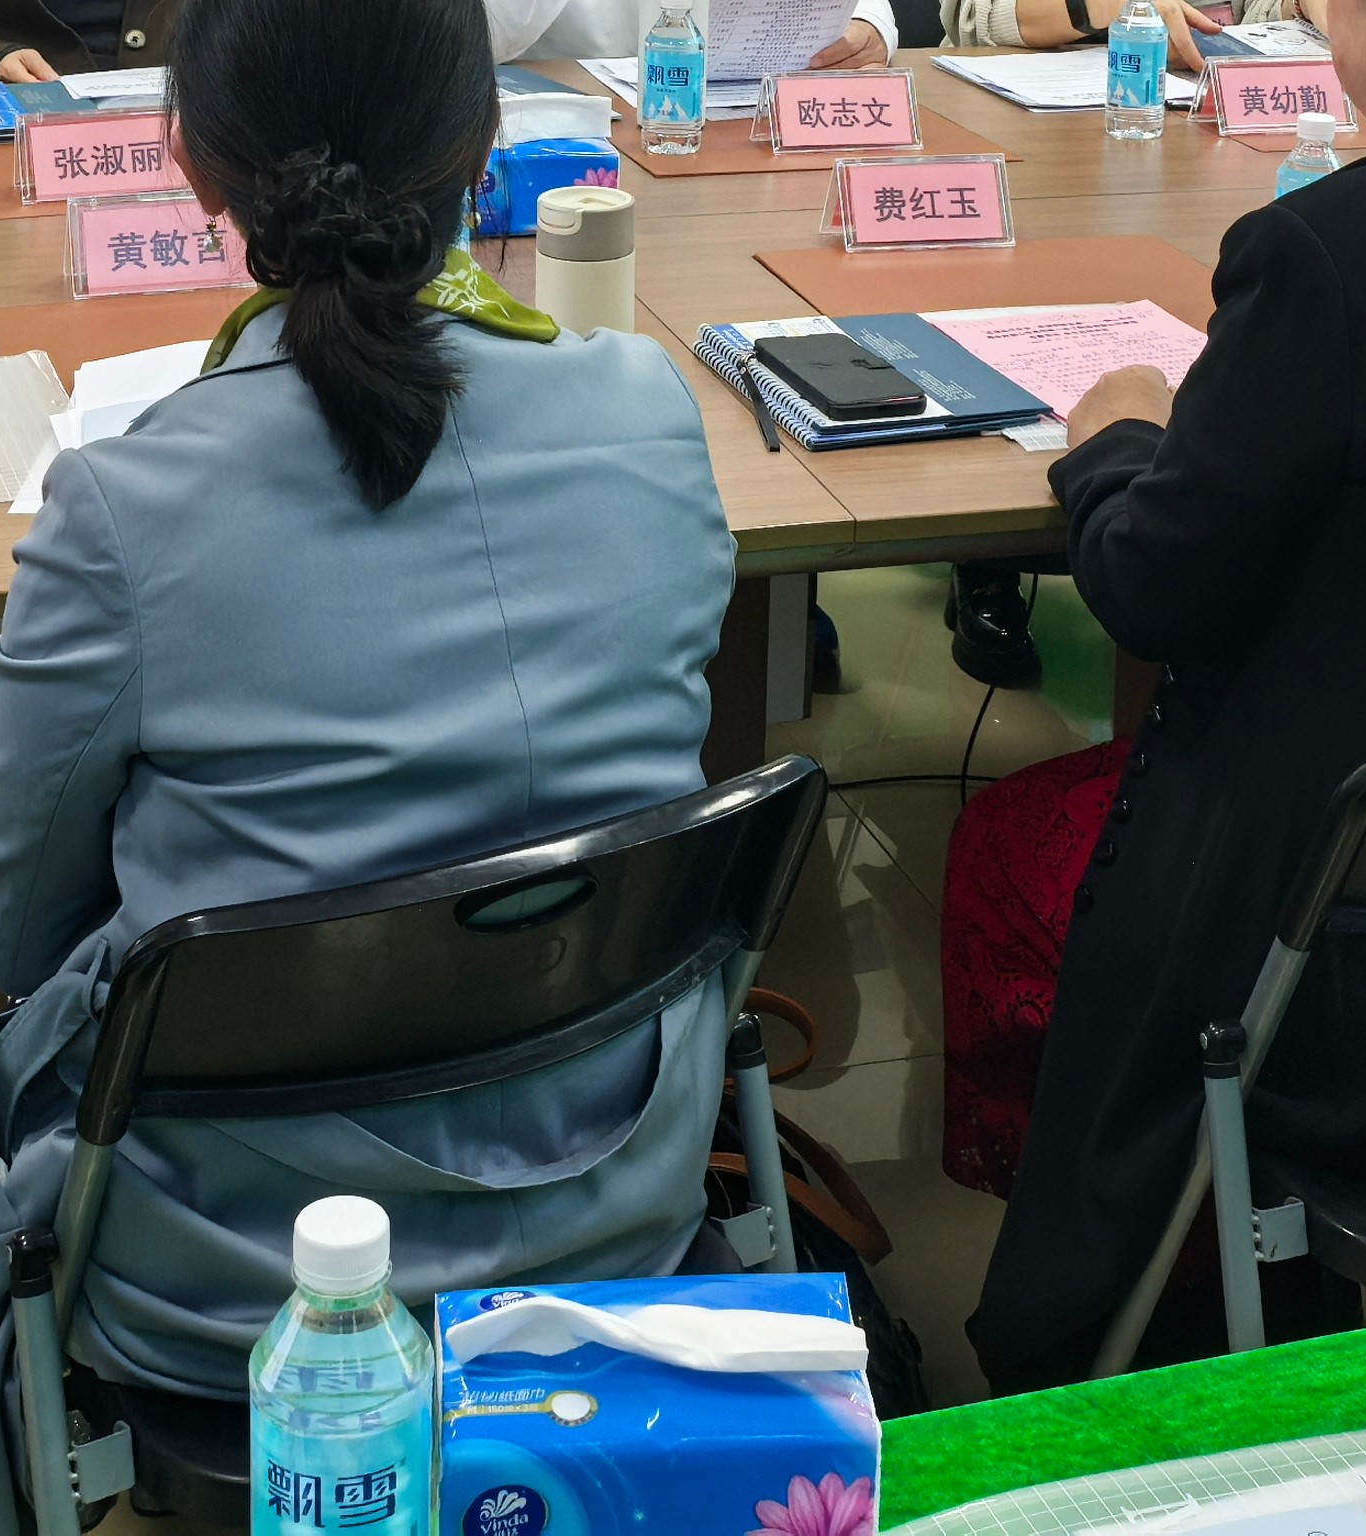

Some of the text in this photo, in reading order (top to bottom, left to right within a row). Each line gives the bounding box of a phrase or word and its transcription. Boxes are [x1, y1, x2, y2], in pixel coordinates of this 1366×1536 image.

[798, 97, 894, 128] 欧志文
[1239, 85, 1328, 115] 黄幼勤
[53, 140, 163, 180] 张淑丽
[873, 186, 982, 224] 费红玉
[268, 1458, 397, 1528] 飘雪
[481, 1512, 528, 1534] Vinda
